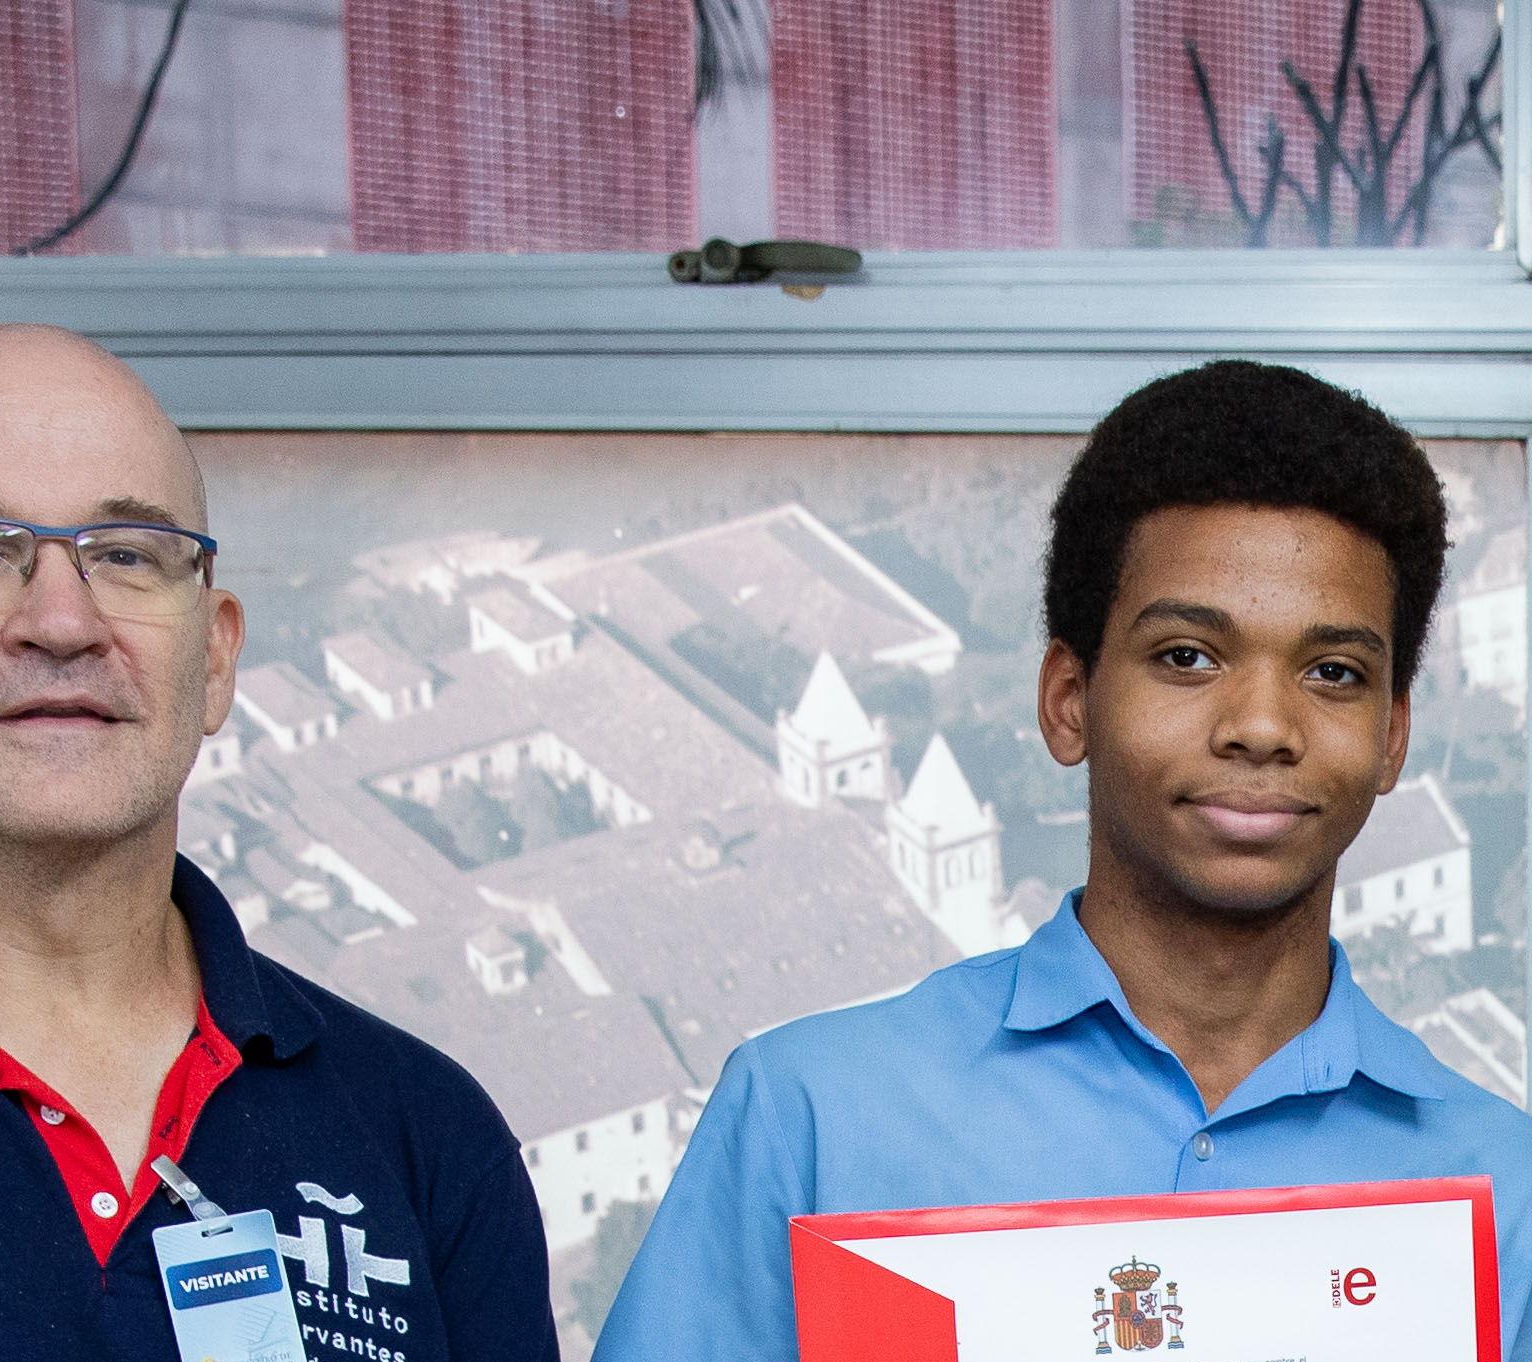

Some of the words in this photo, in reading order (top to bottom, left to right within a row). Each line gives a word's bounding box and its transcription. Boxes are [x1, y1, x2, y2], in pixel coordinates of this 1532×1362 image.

[180, 1265, 270, 1293] VISITANTE
[1331, 1269, 1340, 1297] DELE
[1344, 1267, 1376, 1306] e
[296, 1290, 409, 1334] stituto
